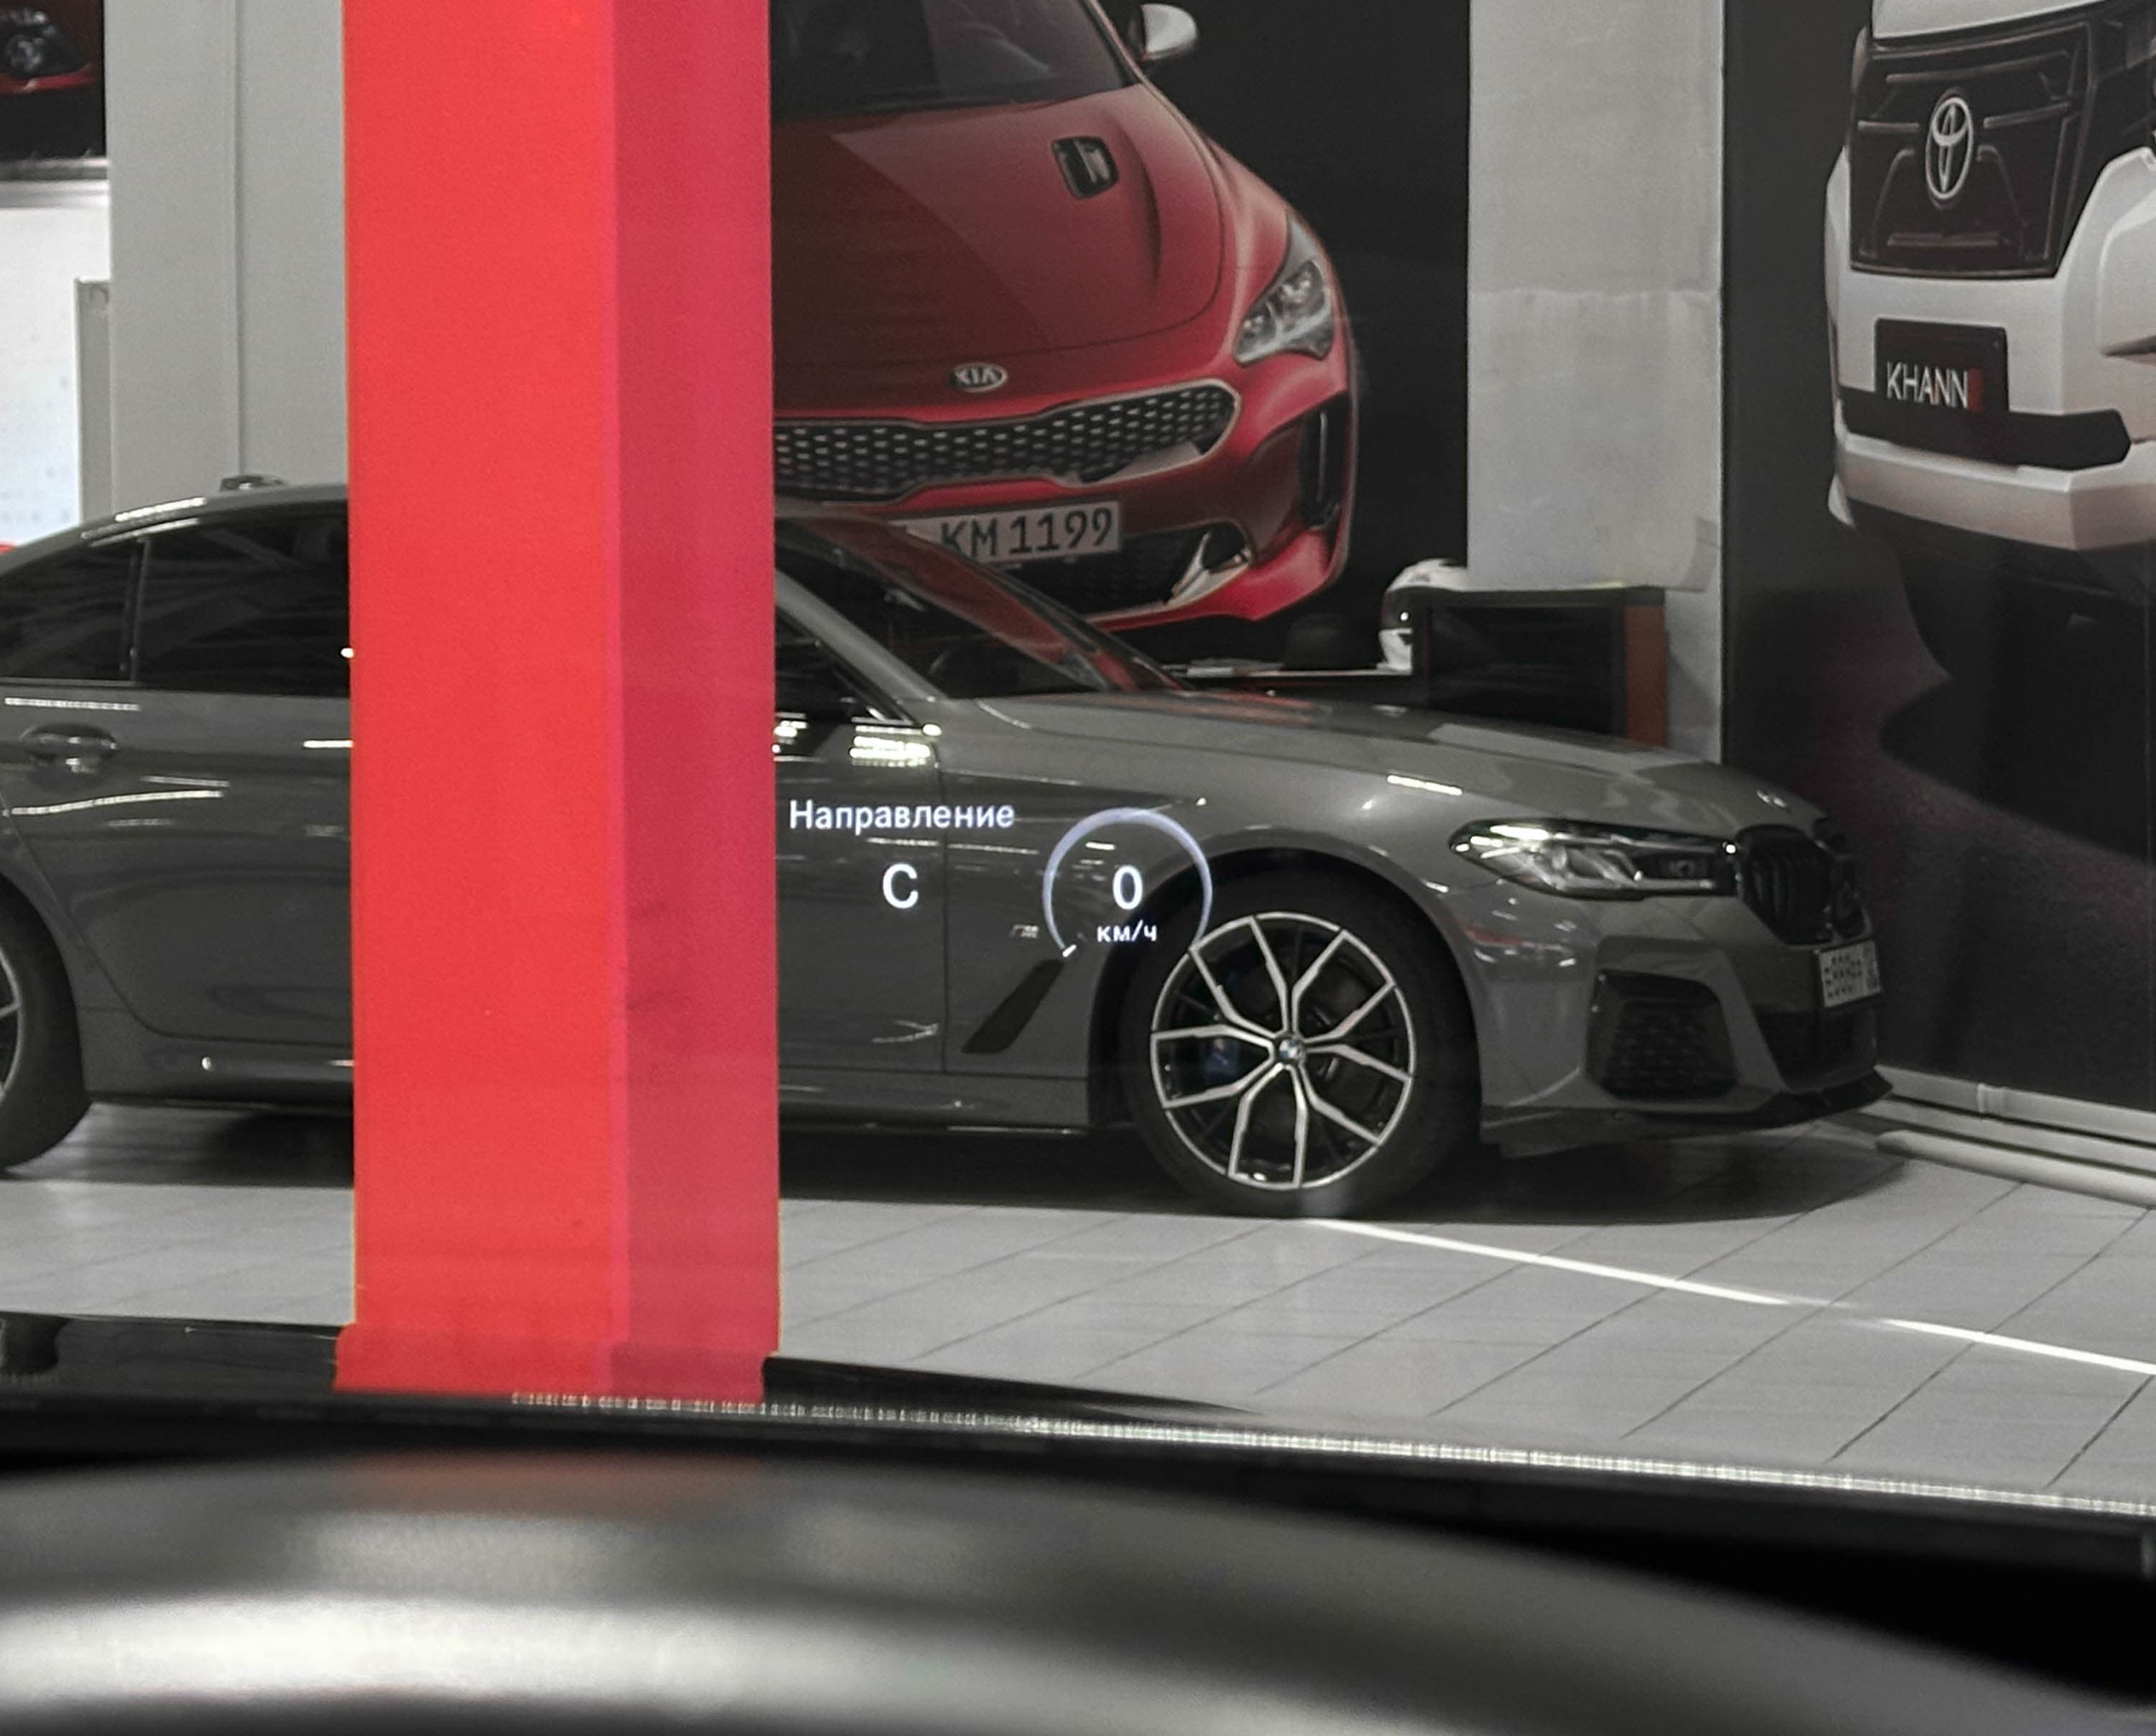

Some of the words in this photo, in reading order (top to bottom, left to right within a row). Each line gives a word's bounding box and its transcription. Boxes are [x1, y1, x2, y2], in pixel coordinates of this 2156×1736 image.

[956, 367, 1000, 386] KIA
[1886, 361, 1968, 409] KHANN
[790, 800, 1015, 835] Направление
[883, 864, 919, 909] С
[1112, 866, 1143, 910] 0
[1096, 920, 1158, 942] км/ч
